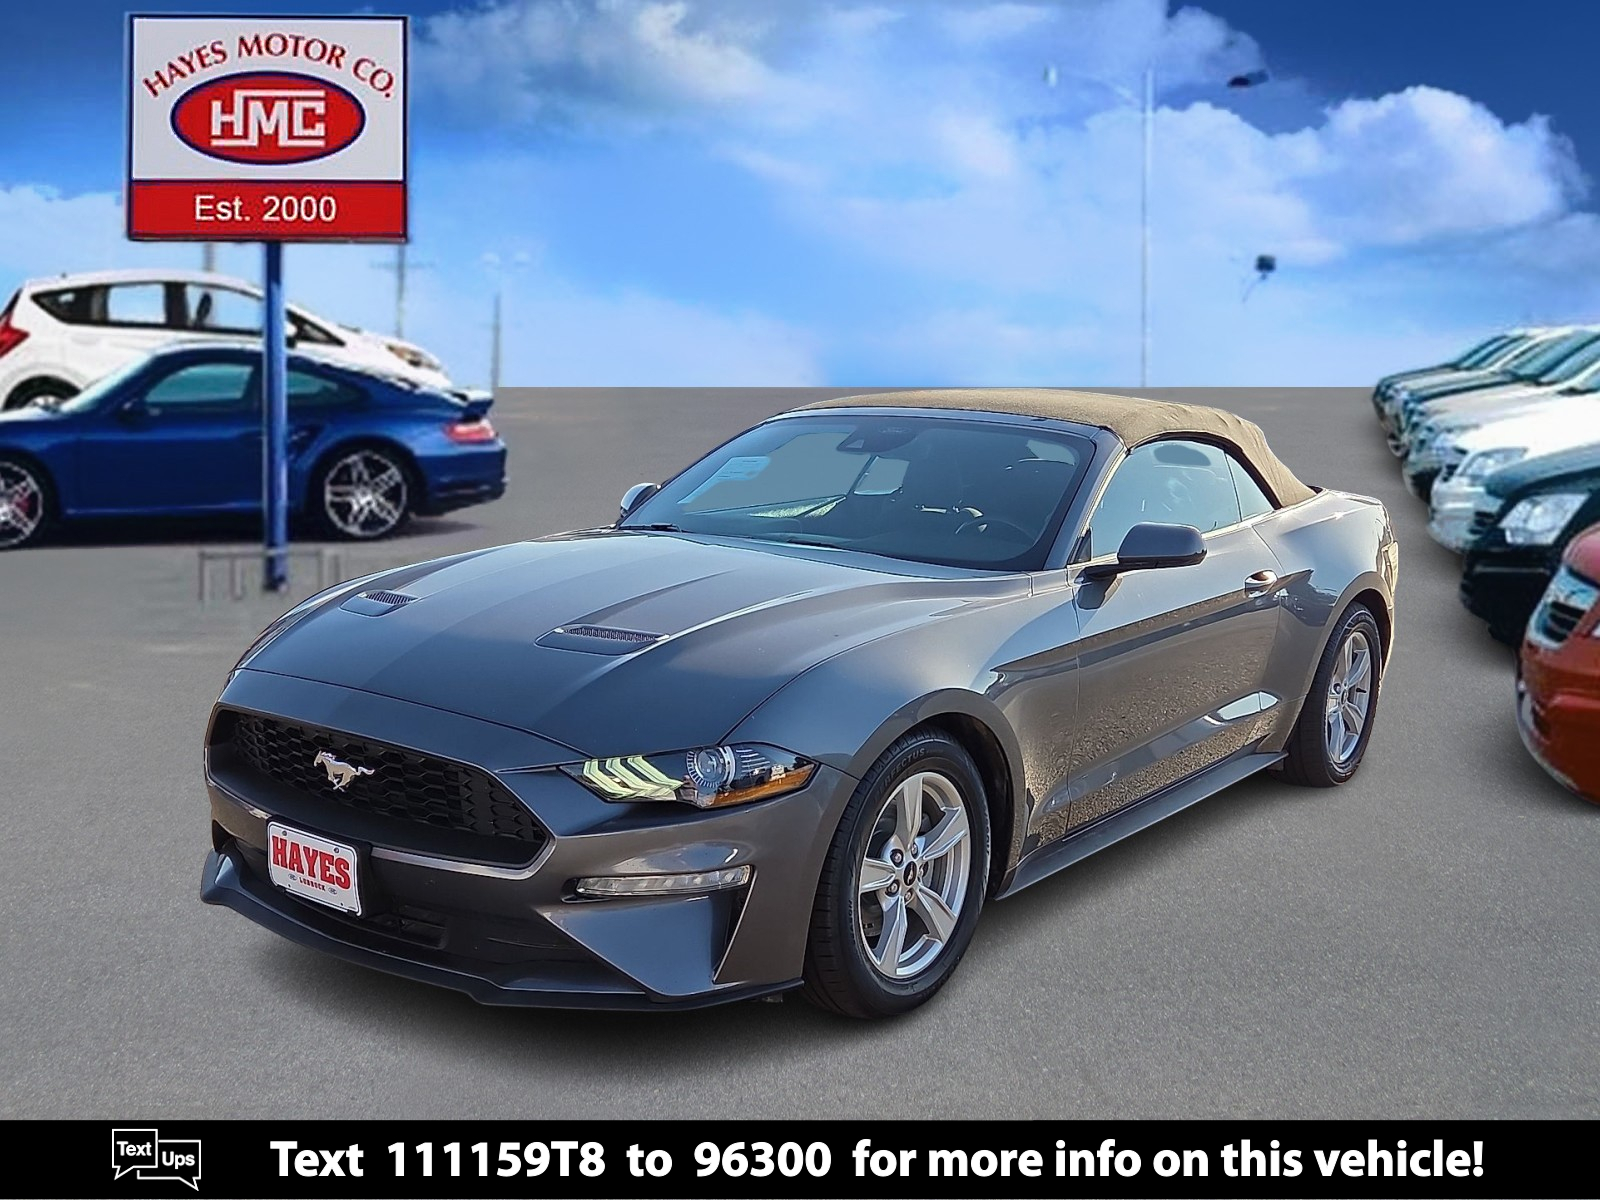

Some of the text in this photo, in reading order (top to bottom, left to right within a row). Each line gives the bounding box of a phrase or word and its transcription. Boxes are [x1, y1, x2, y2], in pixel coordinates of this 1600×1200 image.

[142, 33, 395, 98] HAYES MOTOR CO.
[210, 89, 326, 147] HMC
[194, 194, 337, 222] Est. 2000
[272, 835, 351, 890] HAYES
